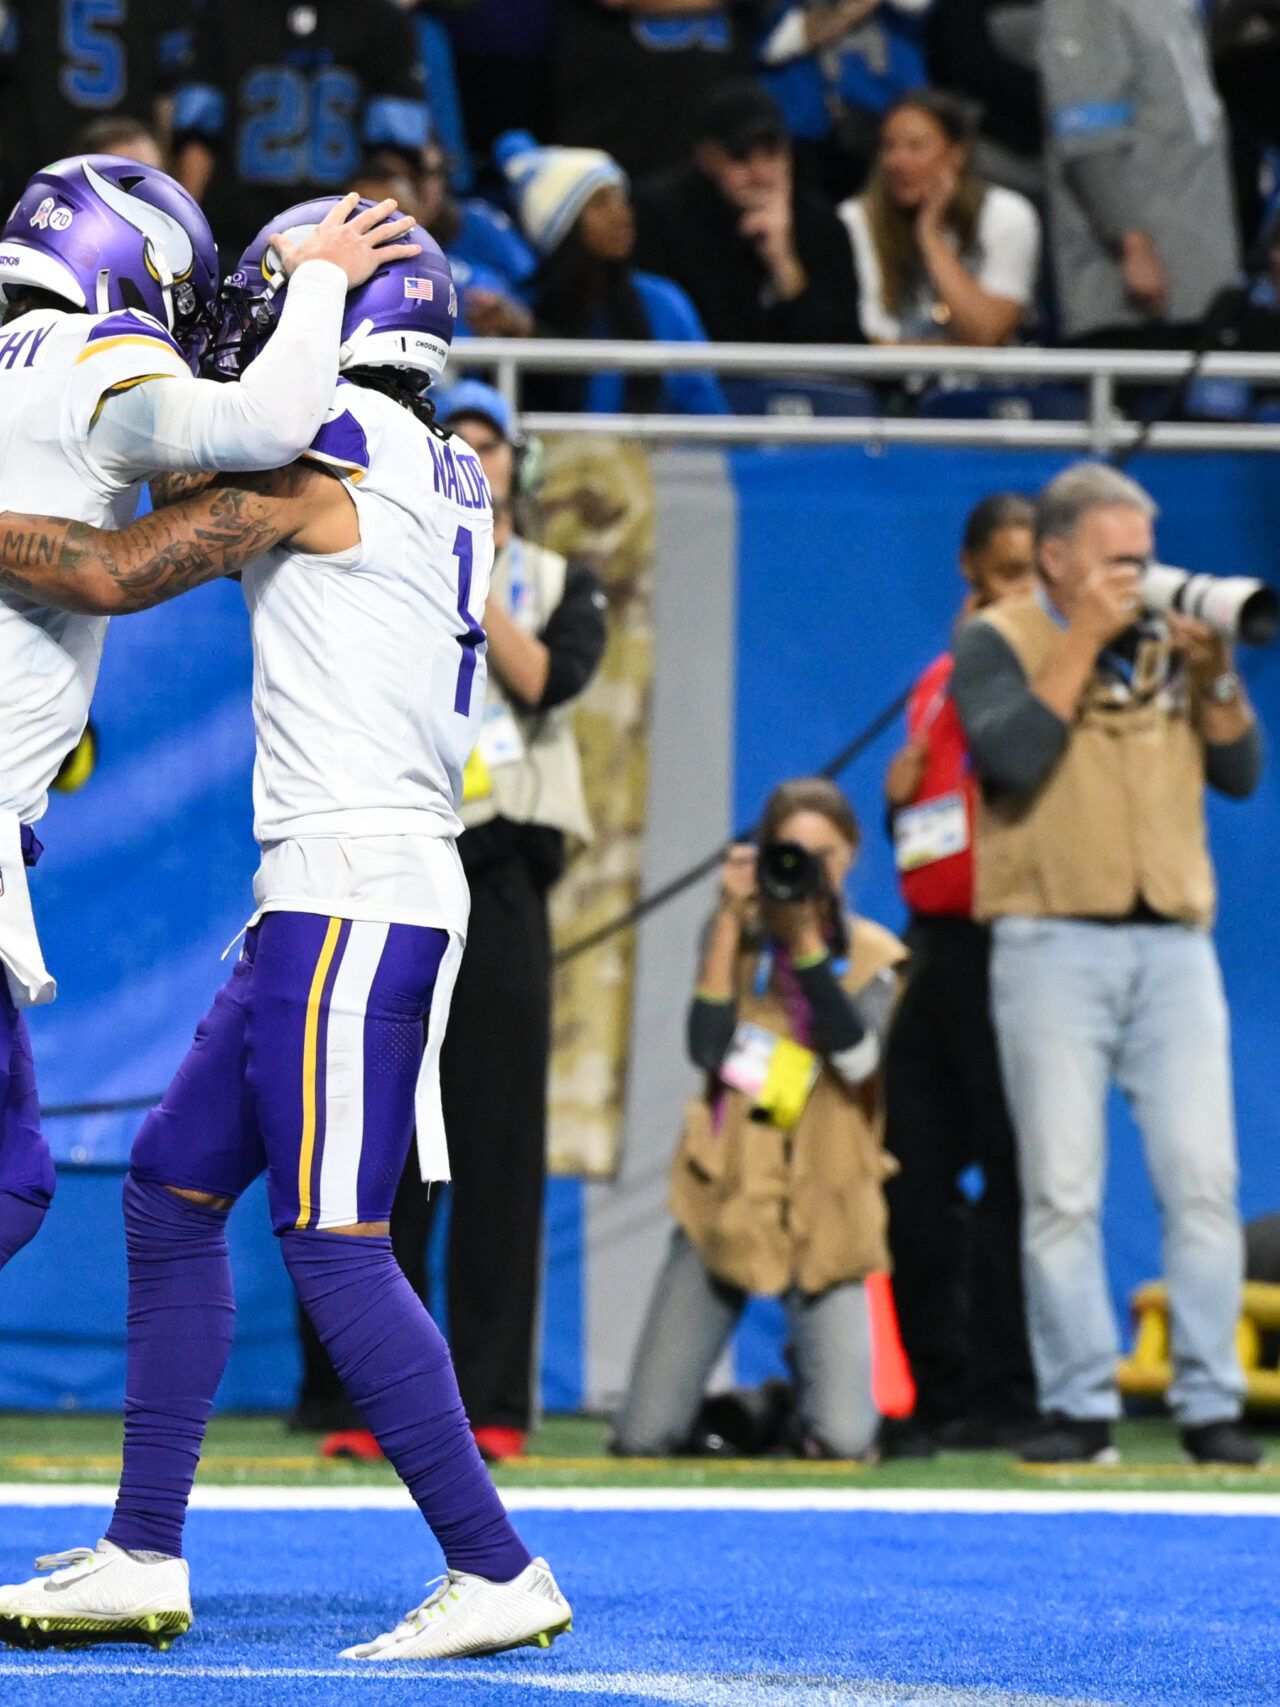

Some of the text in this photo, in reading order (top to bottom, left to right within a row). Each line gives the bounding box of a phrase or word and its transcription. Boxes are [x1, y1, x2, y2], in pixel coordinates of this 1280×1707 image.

[59, 0, 127, 107] 5
[237, 65, 361, 184] 26
[53, 212, 69, 227] 70
[415, 340, 438, 353] CHOOSE
[452, 524, 486, 718] 1
